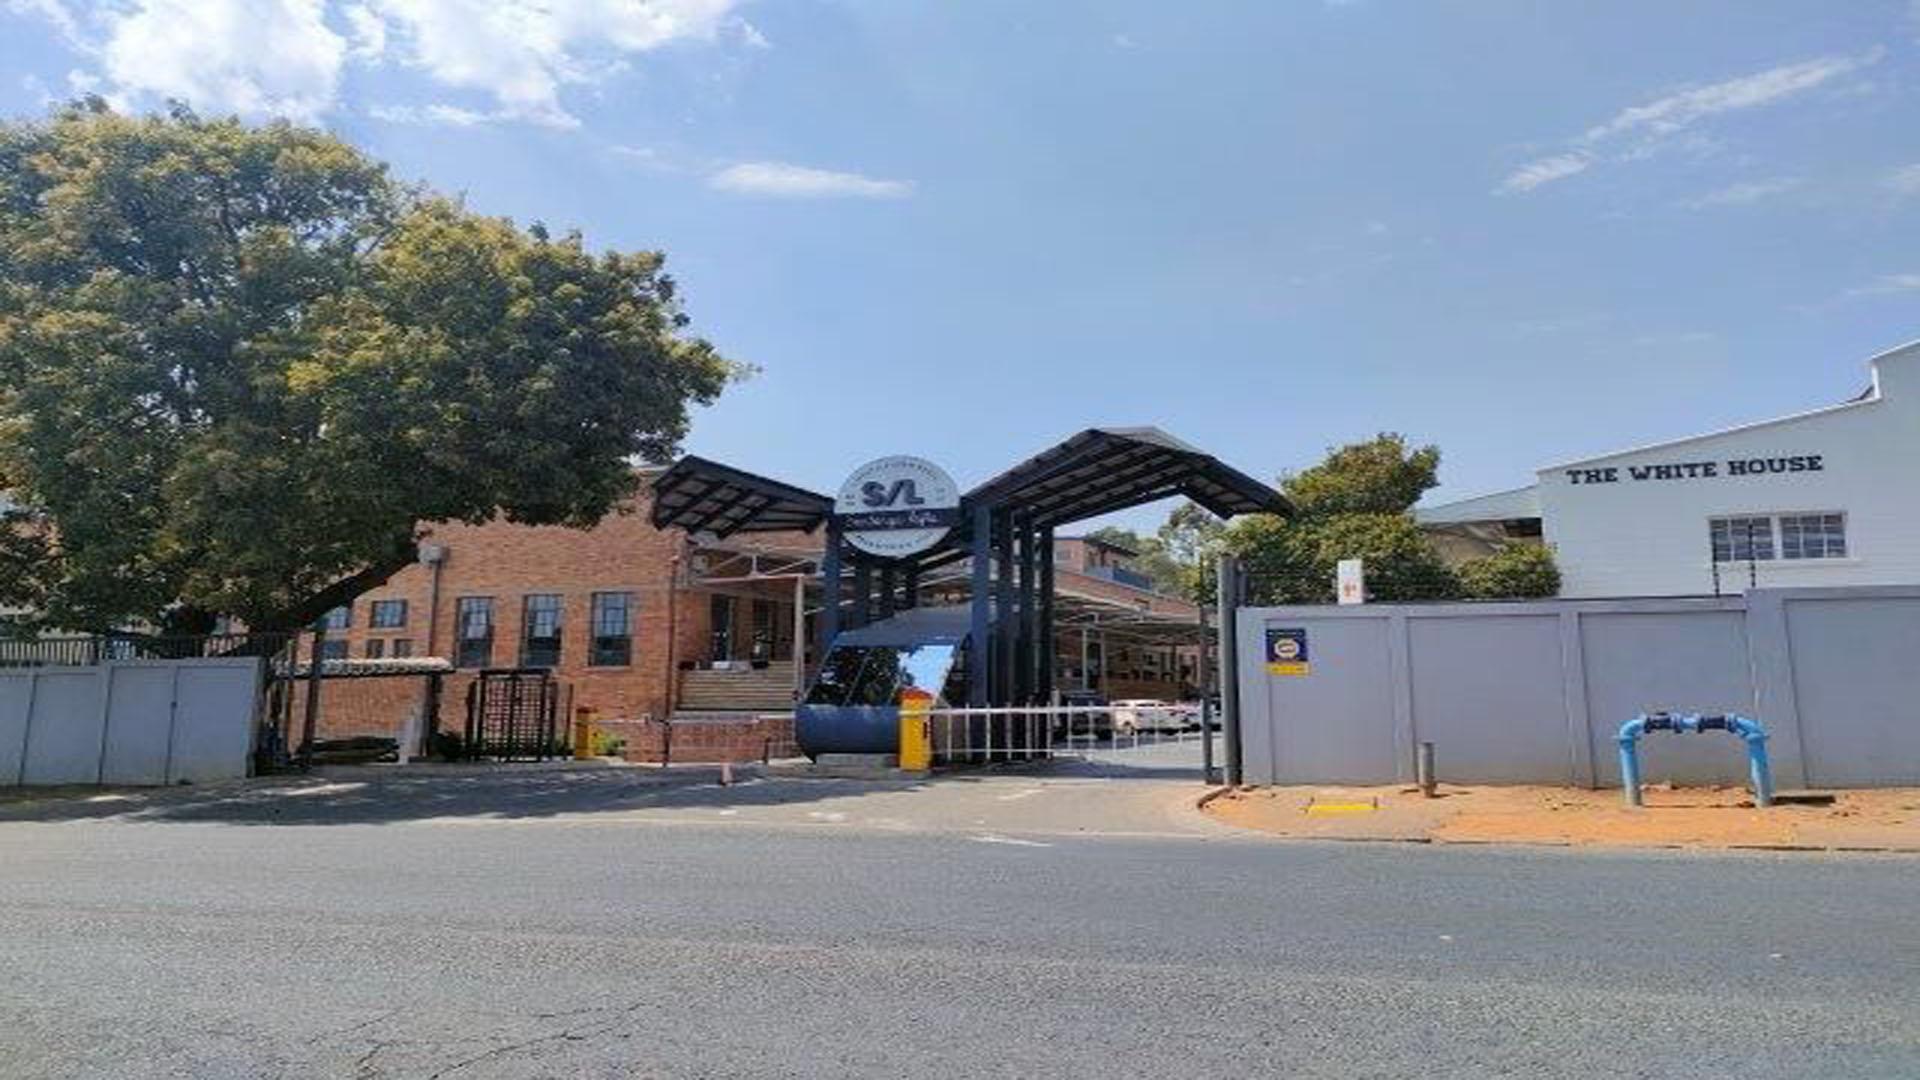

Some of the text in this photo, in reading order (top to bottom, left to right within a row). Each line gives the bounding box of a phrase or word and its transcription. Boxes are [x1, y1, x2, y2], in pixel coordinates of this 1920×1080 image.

[1566, 456, 1823, 484] THE WHITE HOUSE
